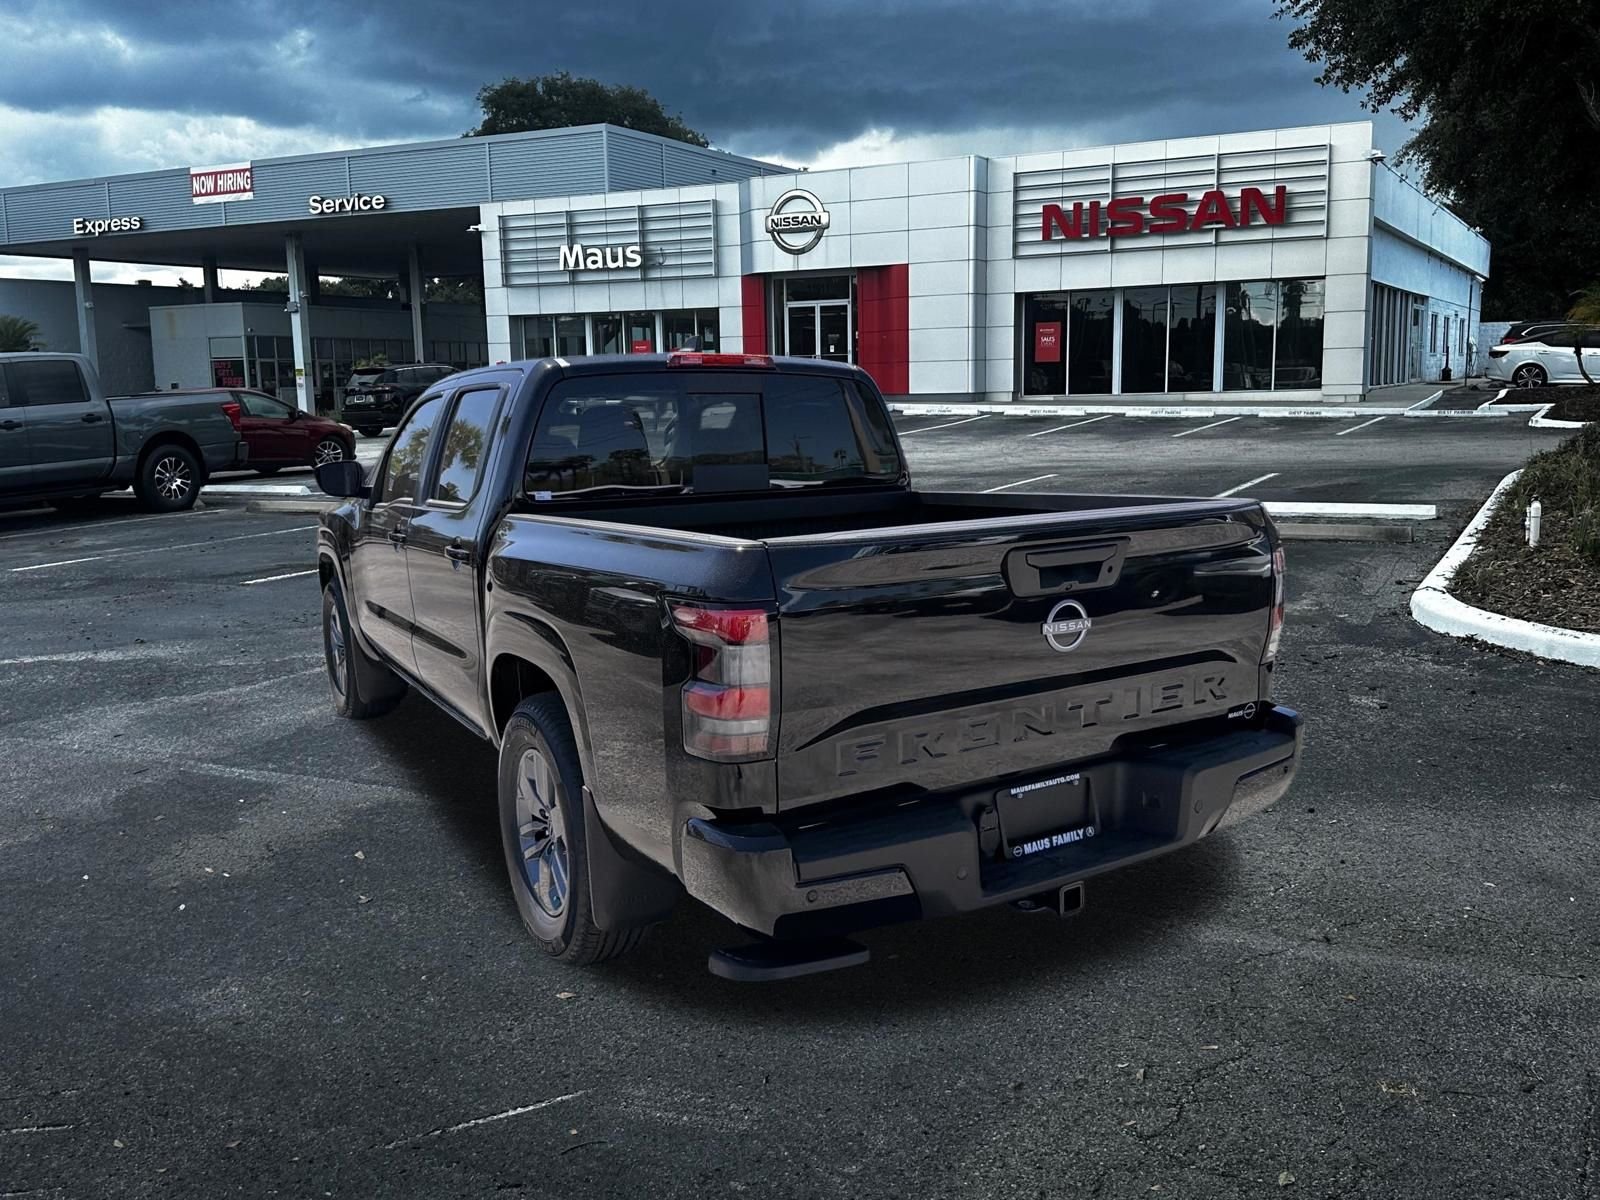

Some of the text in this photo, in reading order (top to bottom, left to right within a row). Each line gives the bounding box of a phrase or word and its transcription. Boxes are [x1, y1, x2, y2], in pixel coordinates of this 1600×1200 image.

[192, 171, 251, 194] NOW HIRING
[309, 193, 386, 215] Service
[1042, 185, 1287, 241] NISSAN
[73, 216, 141, 236] Express
[770, 214, 822, 229] NISSAN
[559, 243, 642, 270] Maus
[1043, 619, 1092, 633] NISSAN
[836, 672, 1228, 776] FRONTIER
[1010, 773, 1080, 795] MAUSFAMILYAUTO.COM
[1023, 828, 1084, 855] MAUS FAMILY
